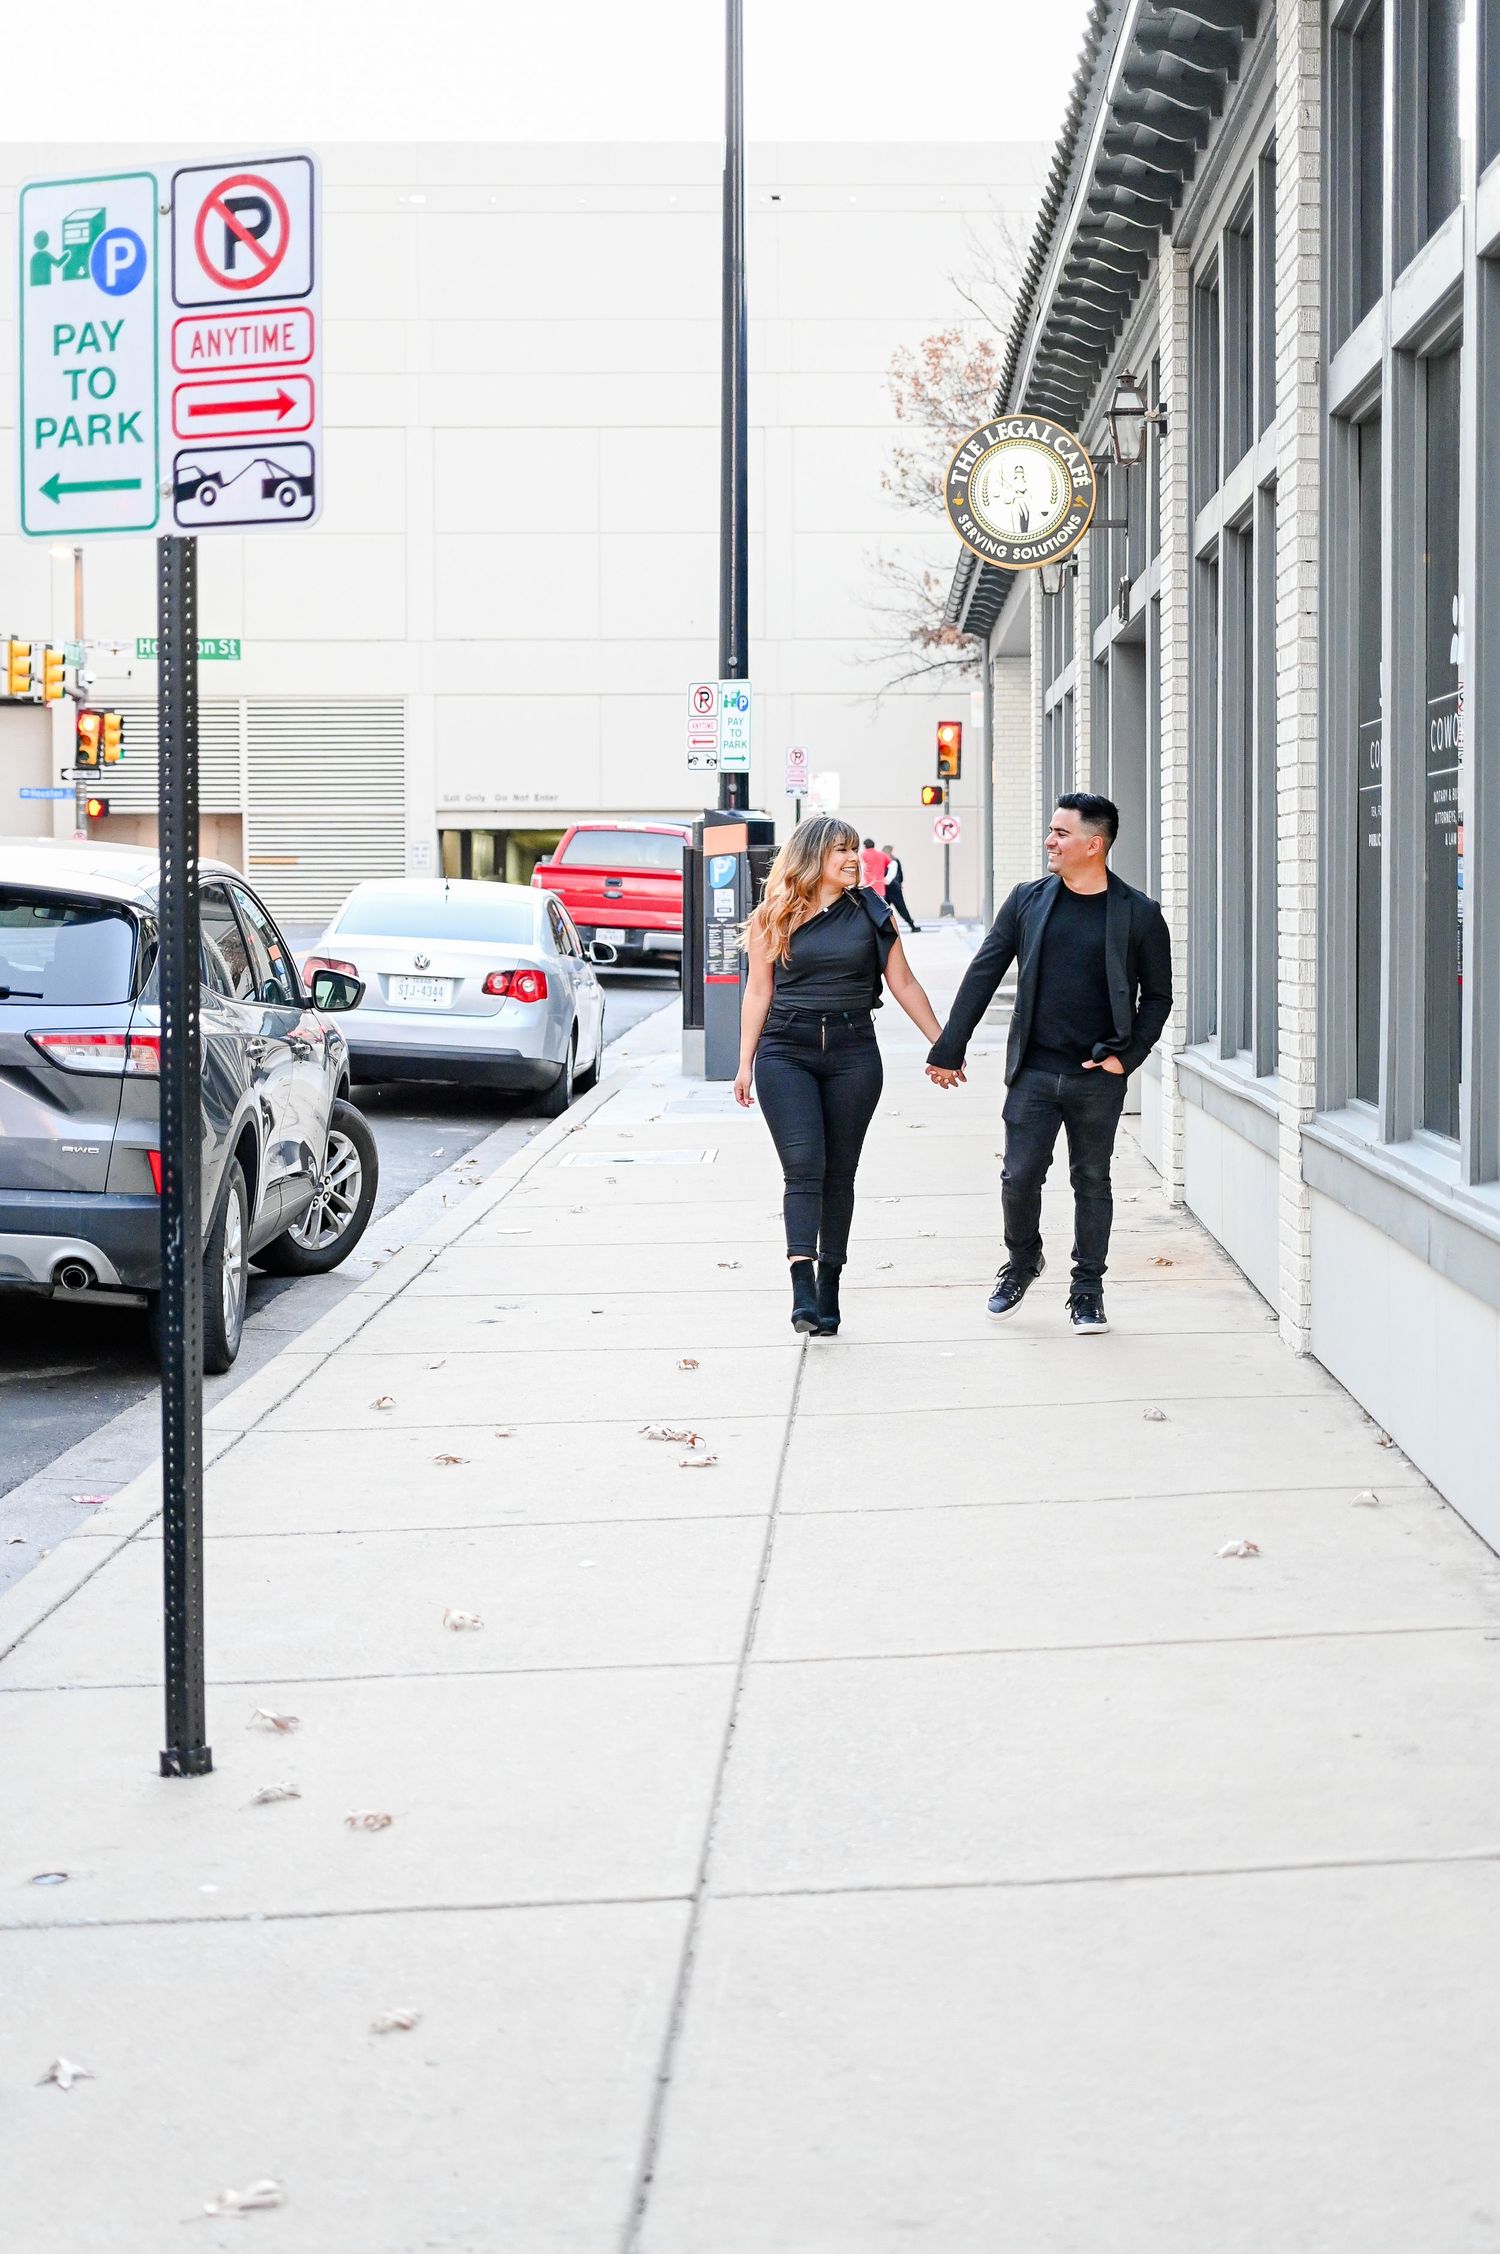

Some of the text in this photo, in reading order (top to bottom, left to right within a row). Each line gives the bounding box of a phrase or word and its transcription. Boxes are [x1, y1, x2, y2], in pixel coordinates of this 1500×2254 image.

[106, 238, 136, 287] P
[53, 319, 125, 356] PAY
[190, 323, 295, 358] ANYTIME
[63, 366, 117, 401] TO
[35, 411, 144, 449] PARK
[951, 439, 984, 485] THE
[983, 420, 1052, 444] LEGAL
[957, 514, 1082, 560] SERVING SOLUTIONS
[139, 639, 216, 654] Hoon
[219, 639, 236, 655] St
[727, 717, 743, 726] PAY
[730, 729, 742, 738] TO
[723, 740, 747, 749] PARK
[1433, 789, 1448, 804] NOTARY
